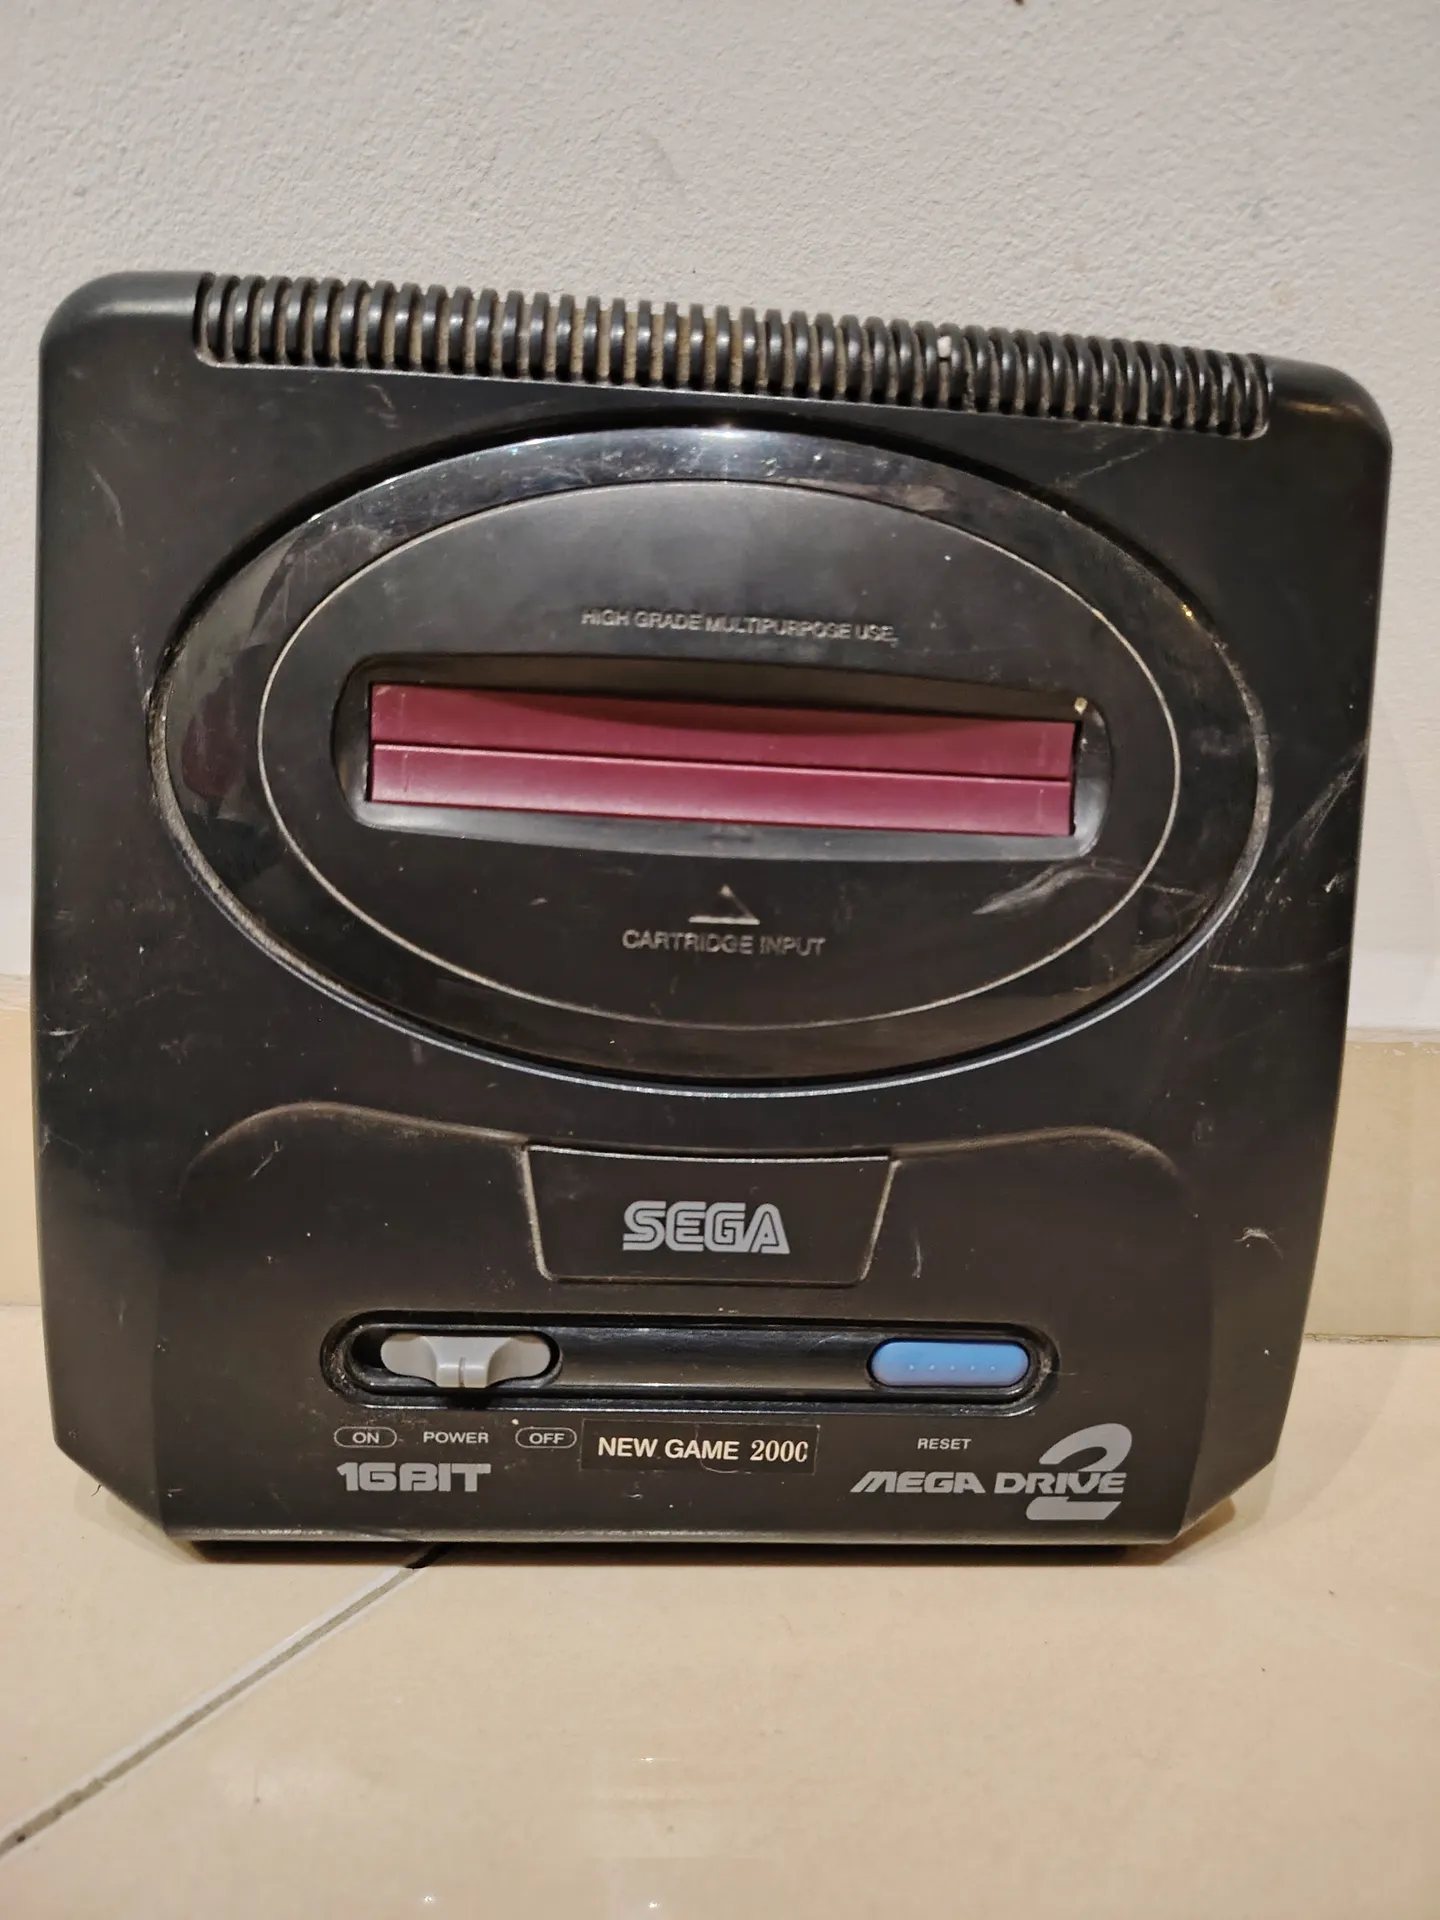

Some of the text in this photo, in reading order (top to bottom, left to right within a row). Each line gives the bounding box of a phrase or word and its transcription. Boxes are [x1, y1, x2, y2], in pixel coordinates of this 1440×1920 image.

[580, 608, 629, 627] HIGH
[634, 610, 702, 631] GRADE
[705, 615, 851, 640] MULTIPURPOSE
[621, 929, 826, 956] CARTRIDGE INPUT
[622, 1199, 791, 1255] SEGA
[352, 1432, 380, 1445] ON
[423, 1431, 489, 1444] POWER
[529, 1432, 565, 1445] OFF
[598, 1437, 658, 1458] NEW
[664, 1439, 740, 1460] GAME
[917, 1438, 971, 1450] RESET
[850, 1471, 986, 1494] MEGA
[994, 1472, 1127, 1494] DRIVE
